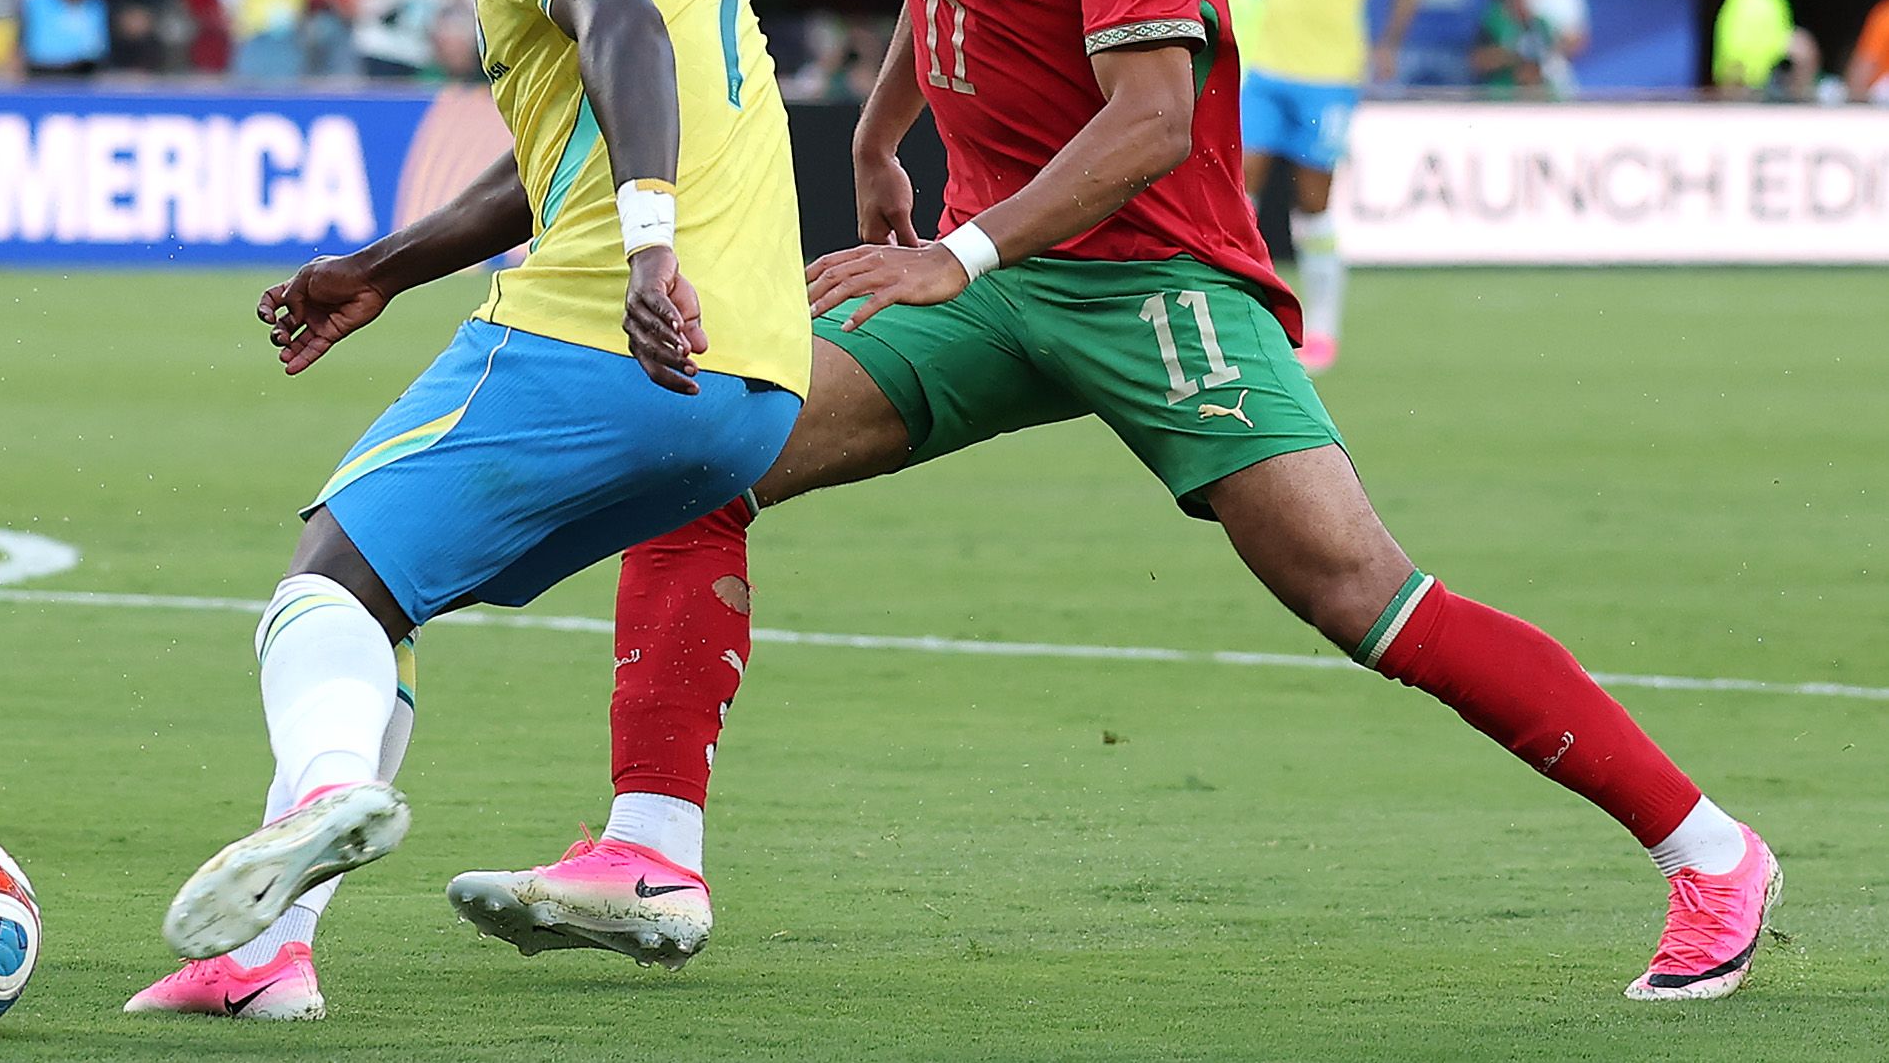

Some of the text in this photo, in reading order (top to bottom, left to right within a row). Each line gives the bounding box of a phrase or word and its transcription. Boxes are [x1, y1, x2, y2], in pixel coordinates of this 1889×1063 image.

[1350, 145, 1889, 225] LAUNCH EDI
[1138, 290, 1242, 406] 11
